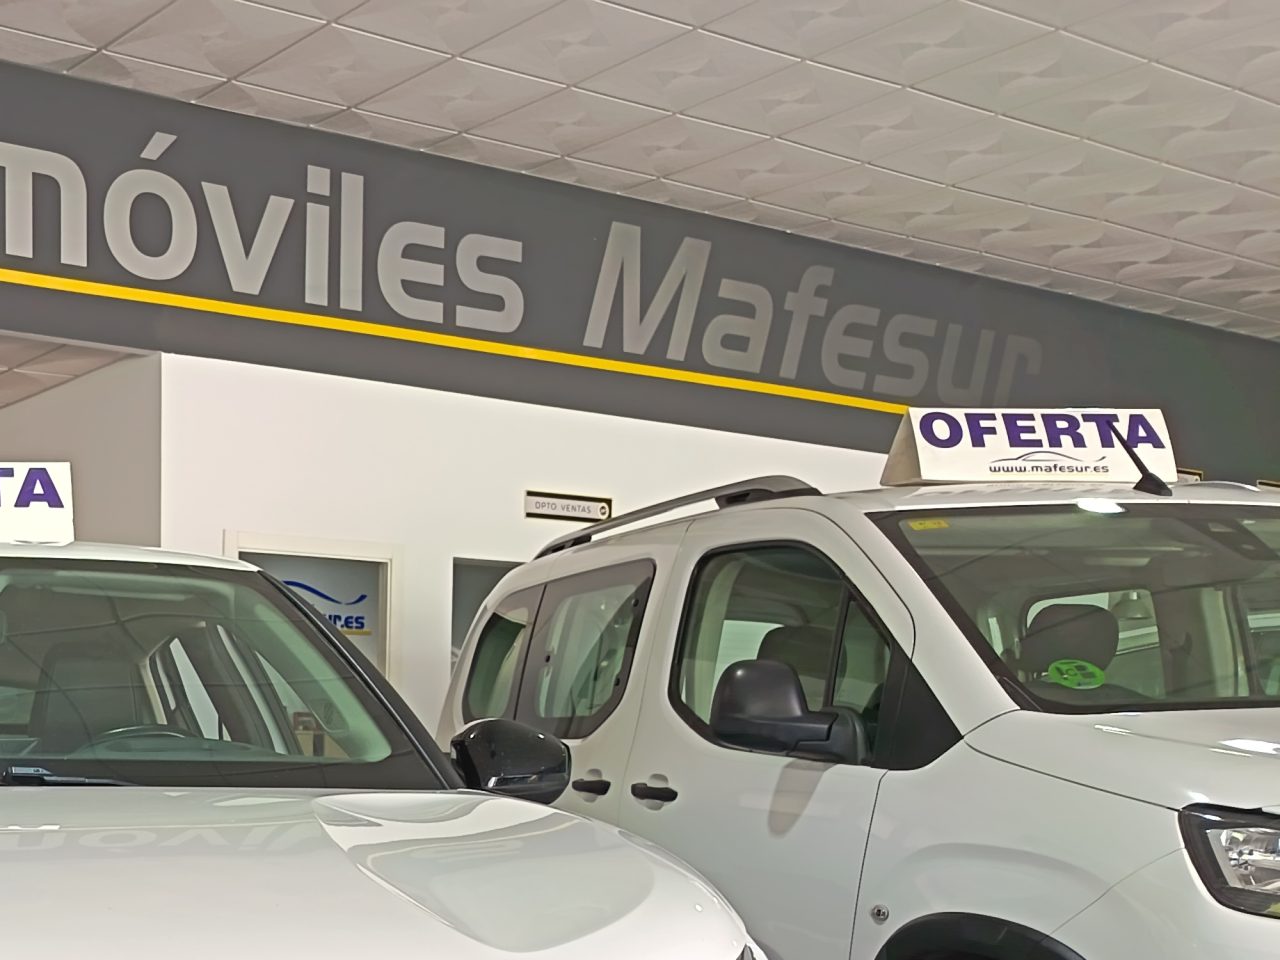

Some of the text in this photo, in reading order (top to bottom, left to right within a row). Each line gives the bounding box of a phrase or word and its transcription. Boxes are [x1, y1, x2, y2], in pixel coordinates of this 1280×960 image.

[582, 220, 1044, 408] Mafesur
[919, 411, 1166, 449] OFERTA
[989, 463, 1110, 475] www.mafesur.es
[561, 504, 592, 514] VENTAS
